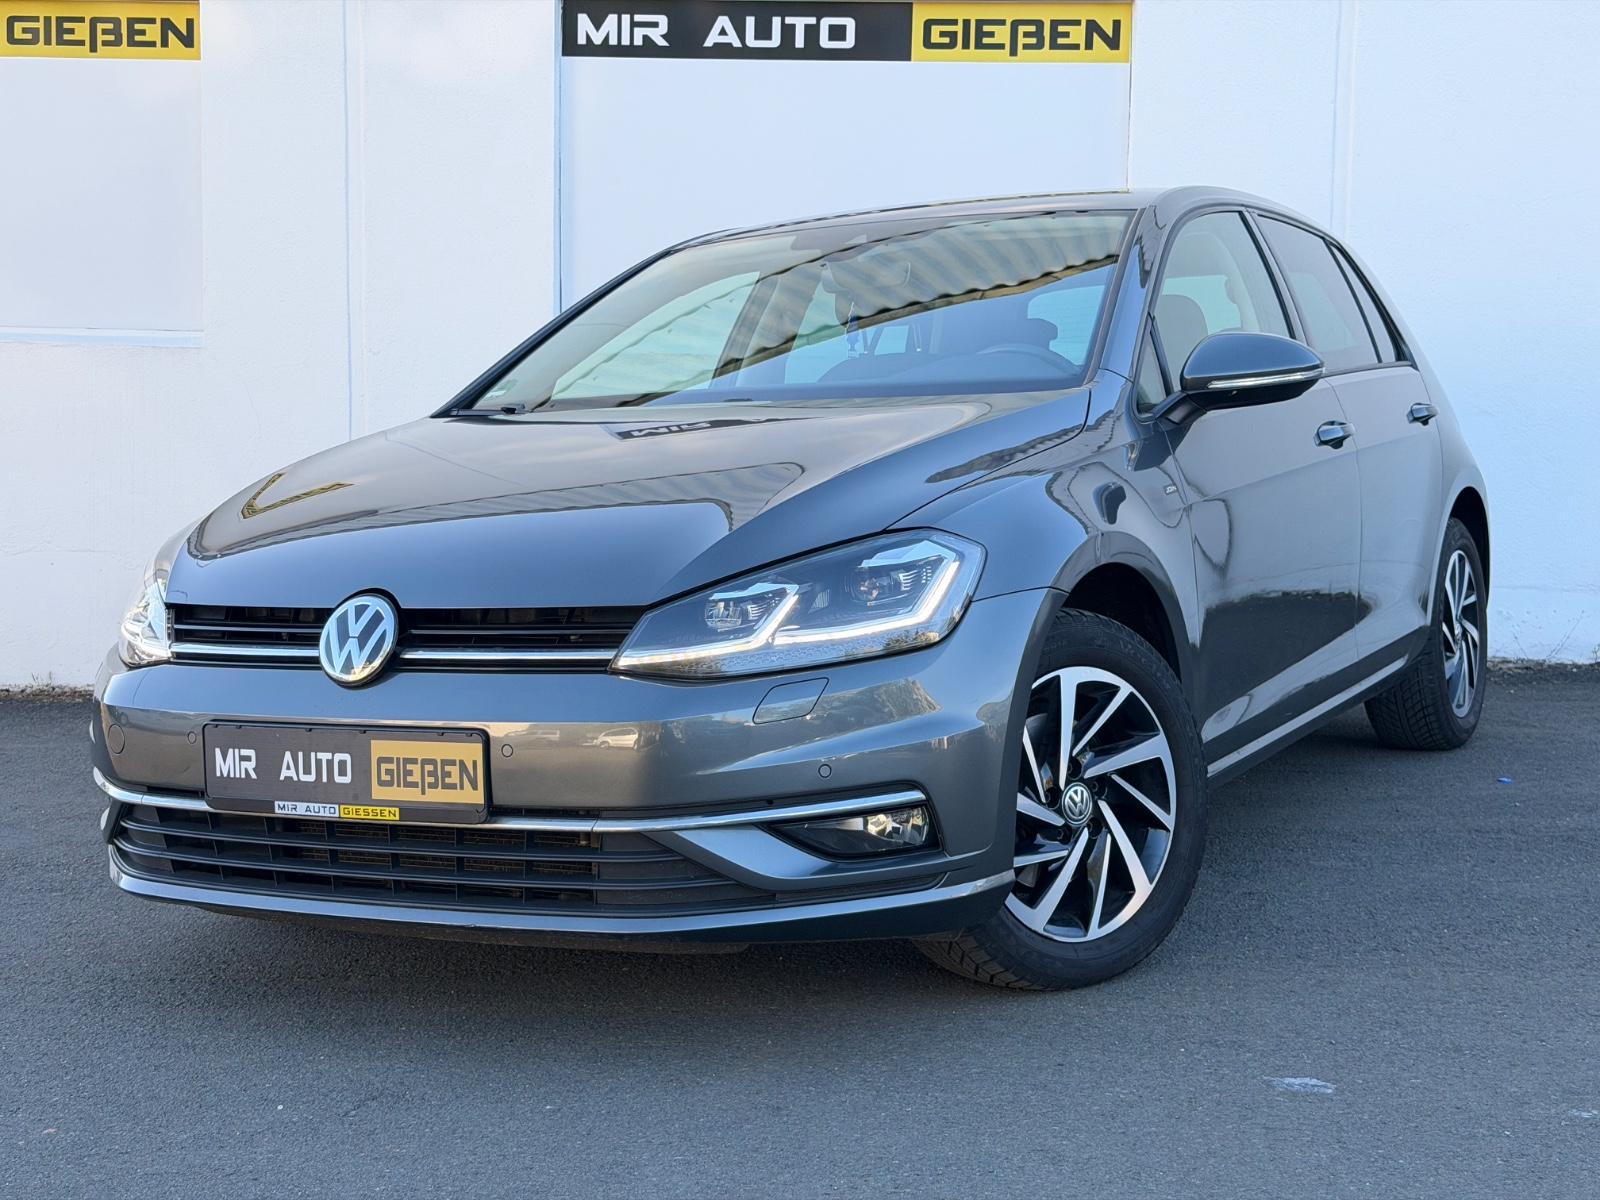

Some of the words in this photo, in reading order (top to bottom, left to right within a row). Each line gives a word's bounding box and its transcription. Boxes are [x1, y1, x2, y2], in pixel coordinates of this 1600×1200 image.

[6, 15, 195, 53] GIEßEN
[577, 13, 670, 47] MIR
[702, 15, 856, 49] AUTO
[922, 18, 1122, 57] GIEßEN
[214, 747, 257, 780] MIR
[279, 750, 352, 784] AUTO
[376, 756, 479, 796] GIEßEN
[277, 803, 298, 812] MIR
[304, 805, 337, 815] AUTO
[342, 807, 397, 818] GIESSEN
